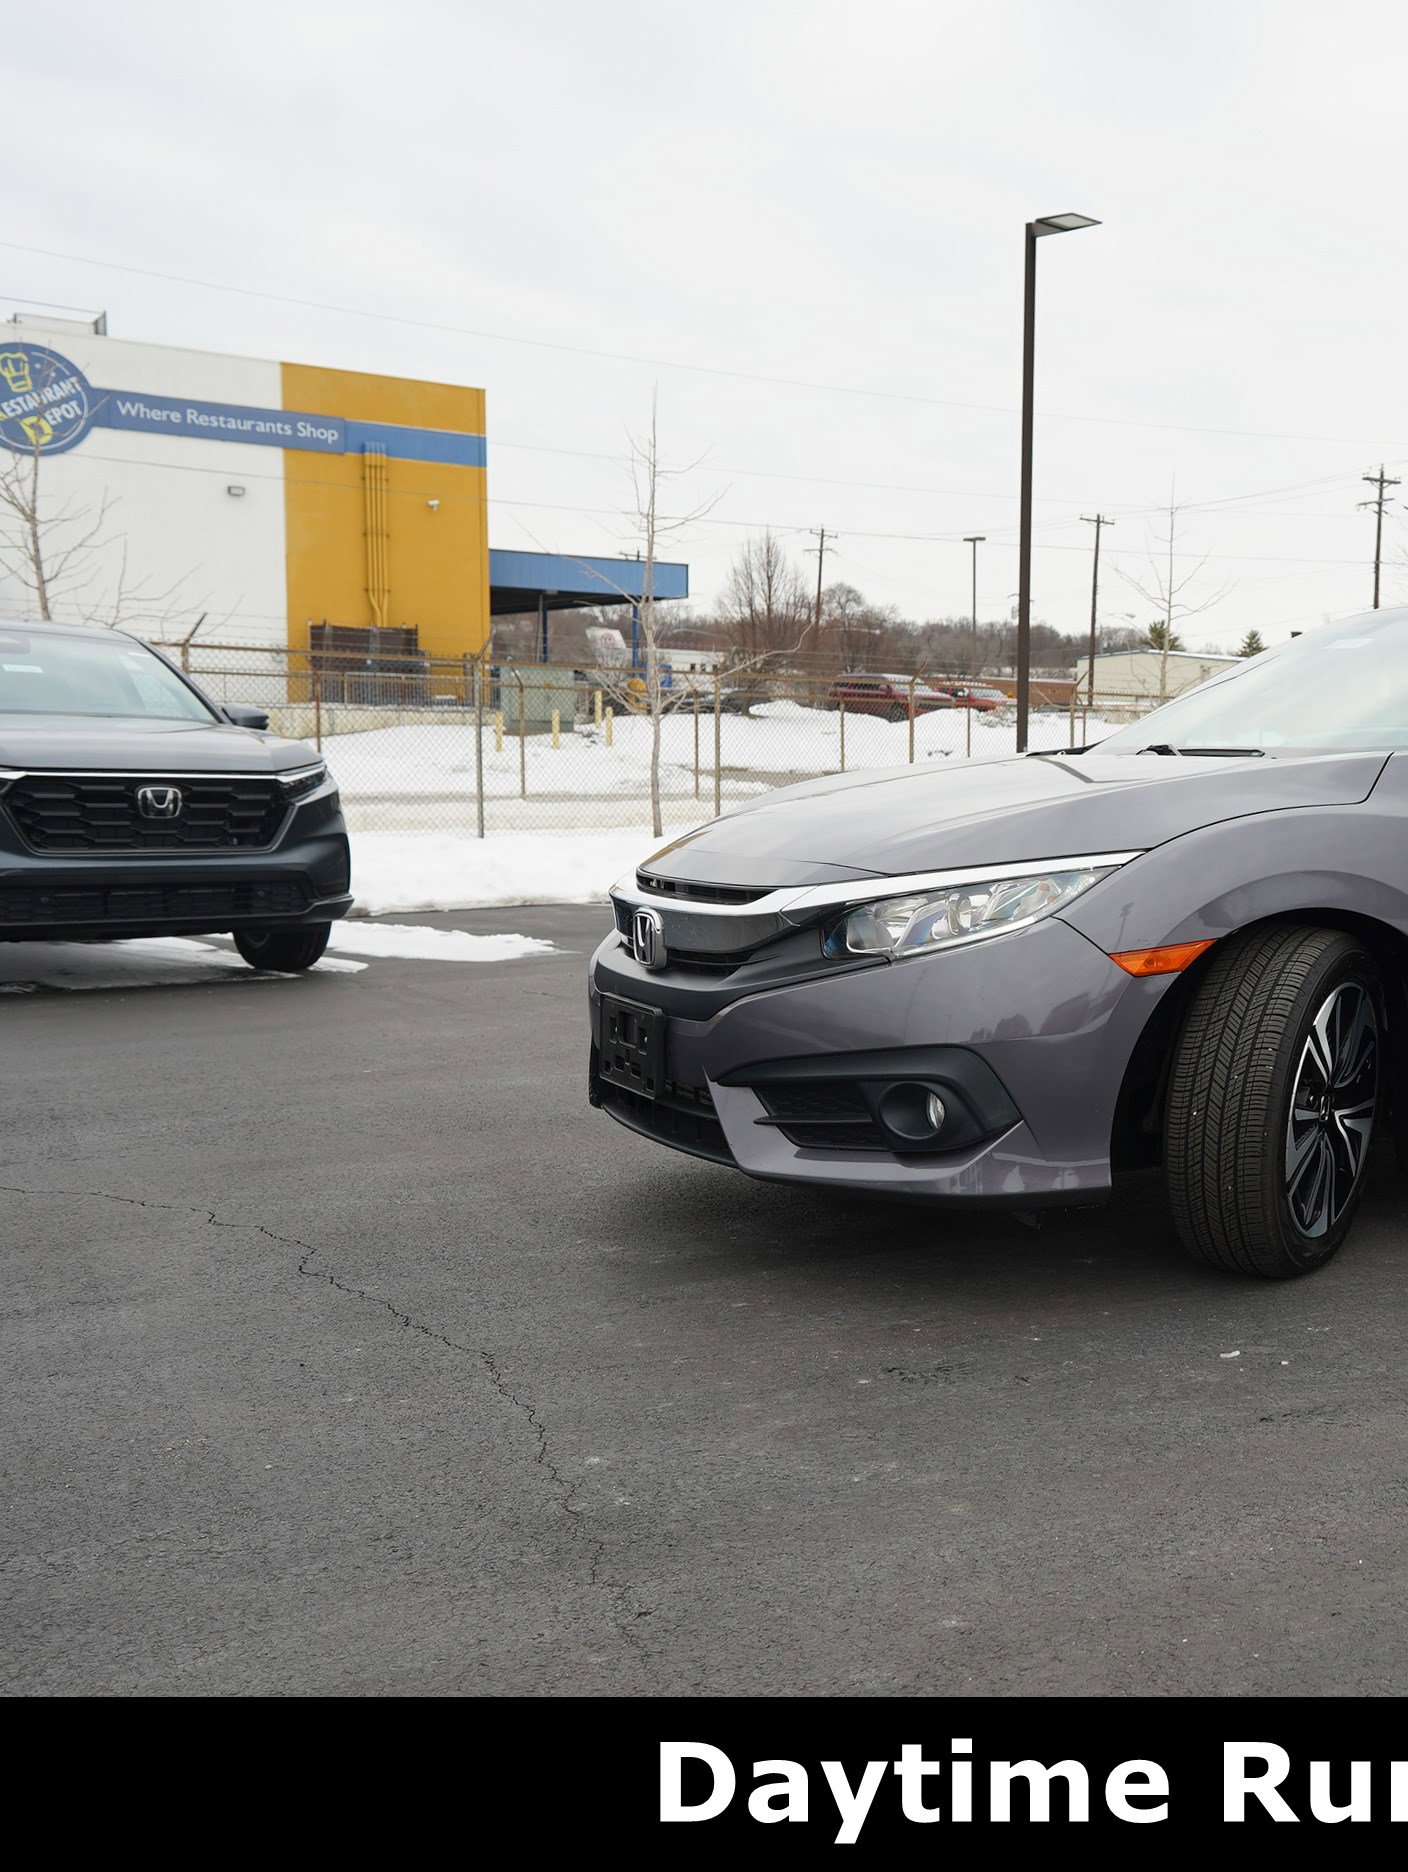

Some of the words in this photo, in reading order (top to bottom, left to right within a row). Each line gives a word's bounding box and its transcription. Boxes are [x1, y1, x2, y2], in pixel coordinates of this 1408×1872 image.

[0, 376, 82, 419] ESTAURANT
[20, 400, 82, 446] DEPOT
[116, 399, 182, 424] Where
[186, 408, 292, 436] Restaurants
[296, 421, 339, 444] Shop
